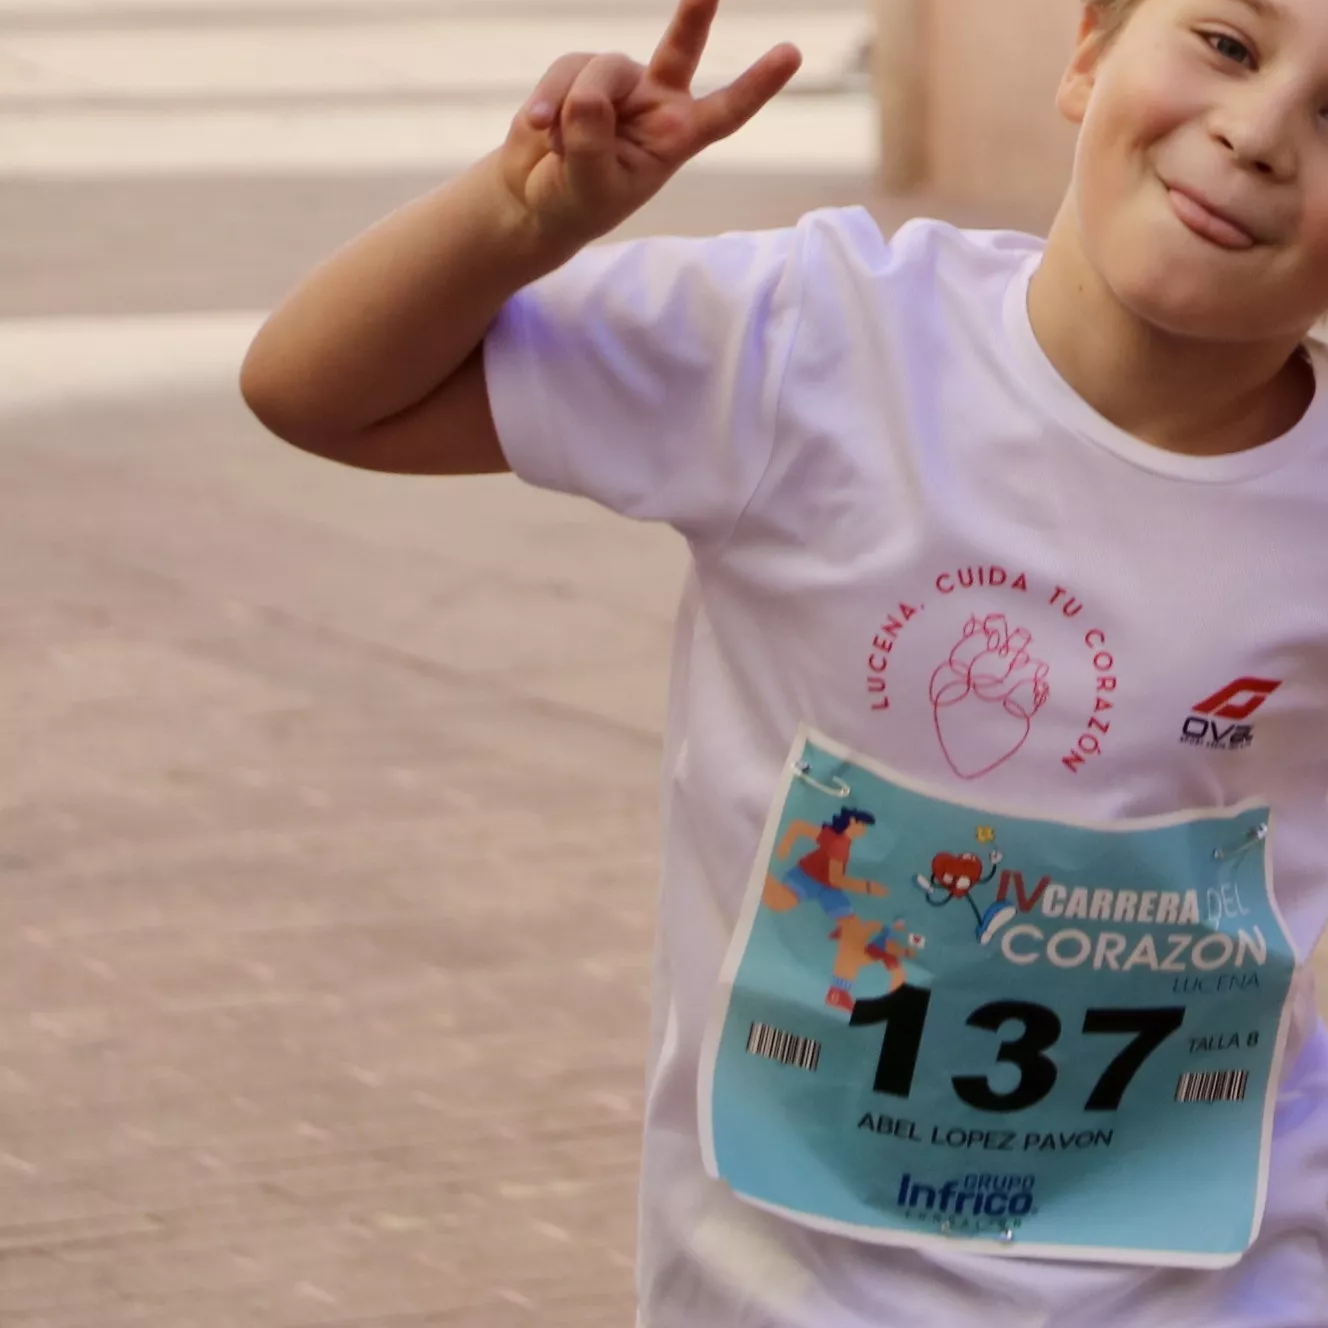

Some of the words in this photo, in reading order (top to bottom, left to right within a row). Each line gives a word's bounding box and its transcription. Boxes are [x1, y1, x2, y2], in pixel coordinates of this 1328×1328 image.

[935, 565, 1028, 595] CUIDA
[1049, 586, 1083, 618] TU
[996, 869, 1053, 913] IV
[1041, 884, 1200, 924] CARRERA
[1206, 883, 1249, 923] DEL
[1172, 973, 1259, 994] LUCENA
[848, 981, 1186, 1113] 137
[1189, 1036, 1240, 1052] TALLA
[857, 1113, 922, 1141] ABEL
[931, 1126, 1017, 1151] LOPEZ
[1023, 1129, 1114, 1151] PAVON
[897, 1173, 1034, 1217] Infrico
[964, 1173, 1035, 1192] GRUPO
